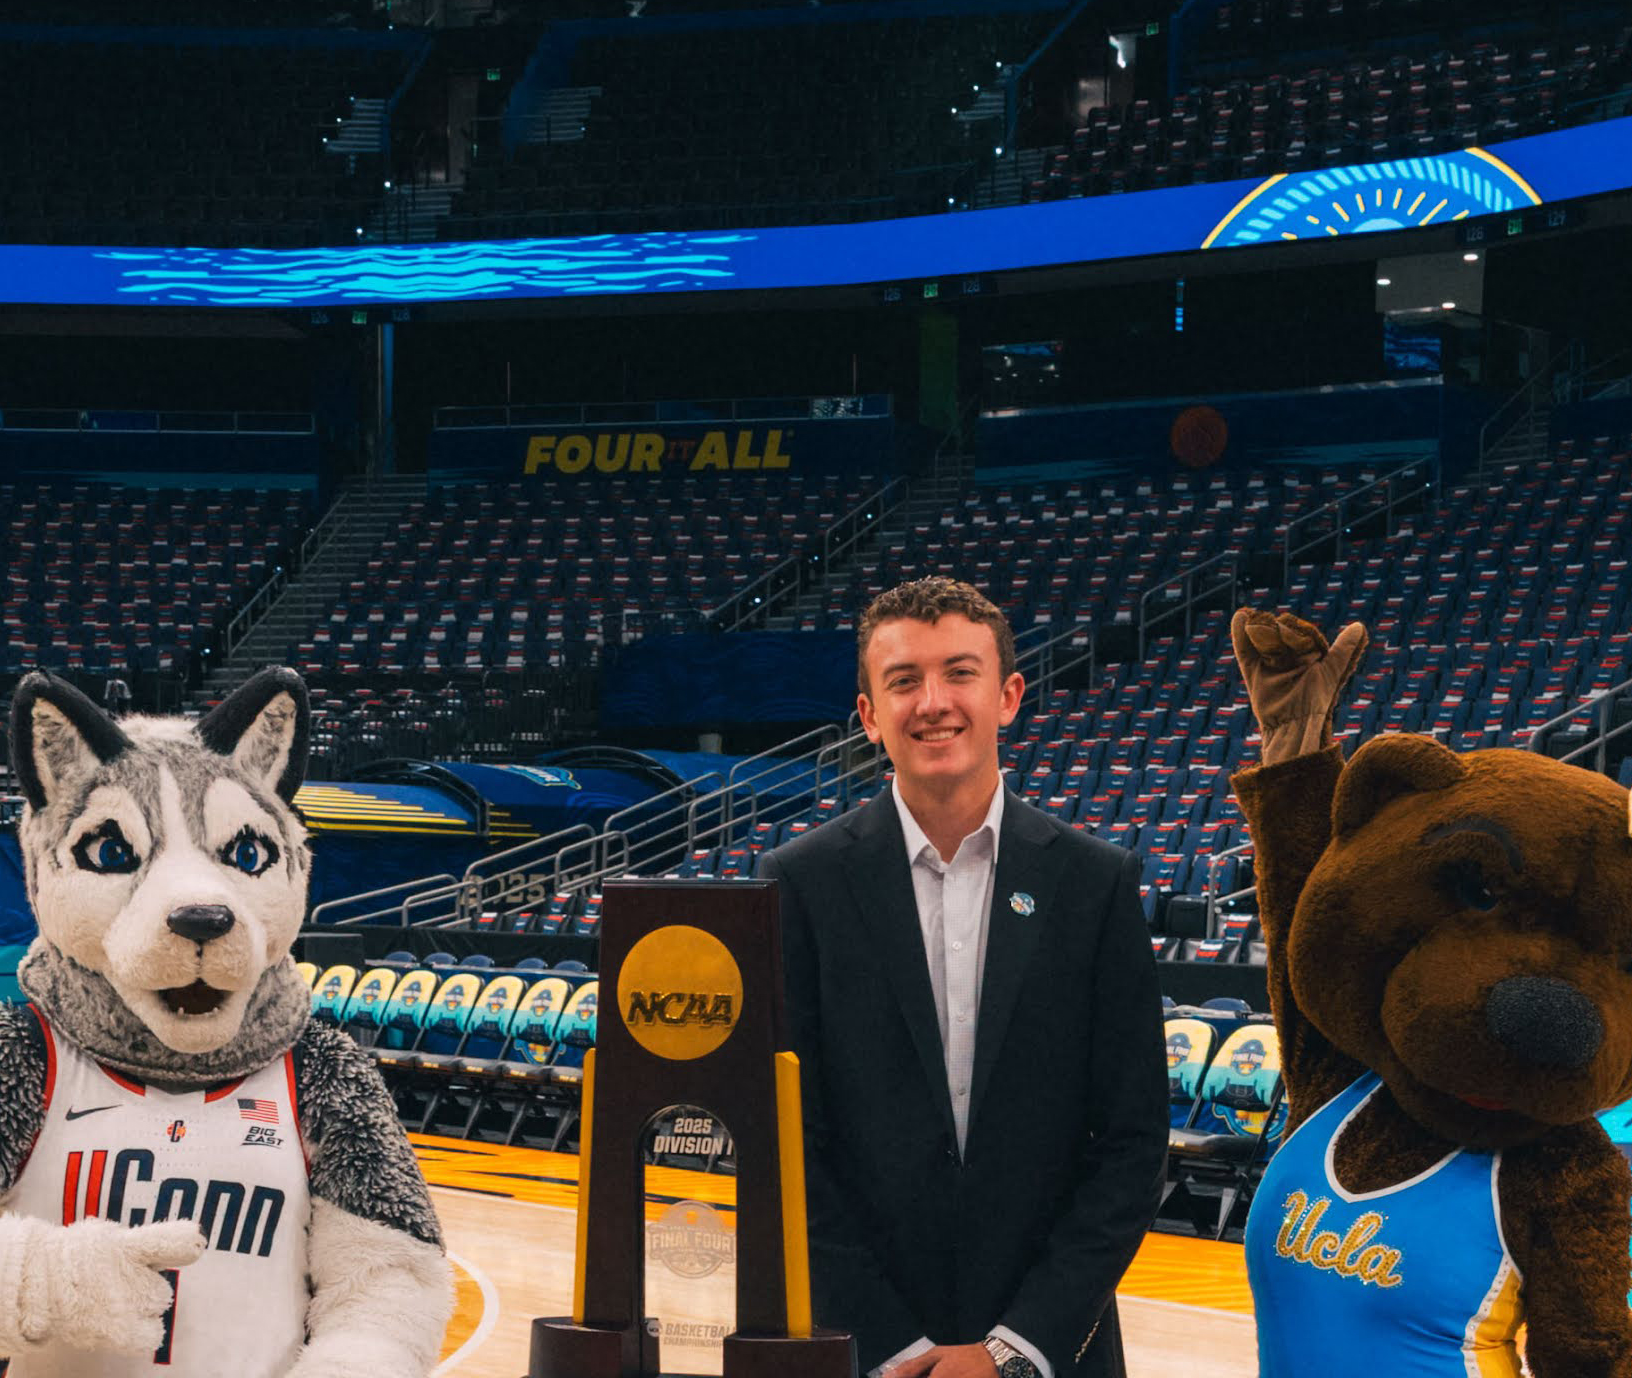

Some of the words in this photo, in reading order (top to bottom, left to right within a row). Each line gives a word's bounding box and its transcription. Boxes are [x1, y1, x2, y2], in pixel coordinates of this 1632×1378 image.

[524, 433, 665, 474] FOUR
[668, 440, 696, 462] IT
[689, 429, 791, 471] ALL
[626, 990, 737, 1028] NCAA
[248, 1126, 277, 1137] BIG
[674, 1117, 713, 1134] 2025
[244, 1134, 285, 1146] EAST
[653, 1135, 725, 1155] DIVISION
[62, 1148, 286, 1258] UConn
[651, 1232, 689, 1250] FINAL
[694, 1232, 733, 1250] FOUR
[1274, 1189, 1406, 1290] Ucla
